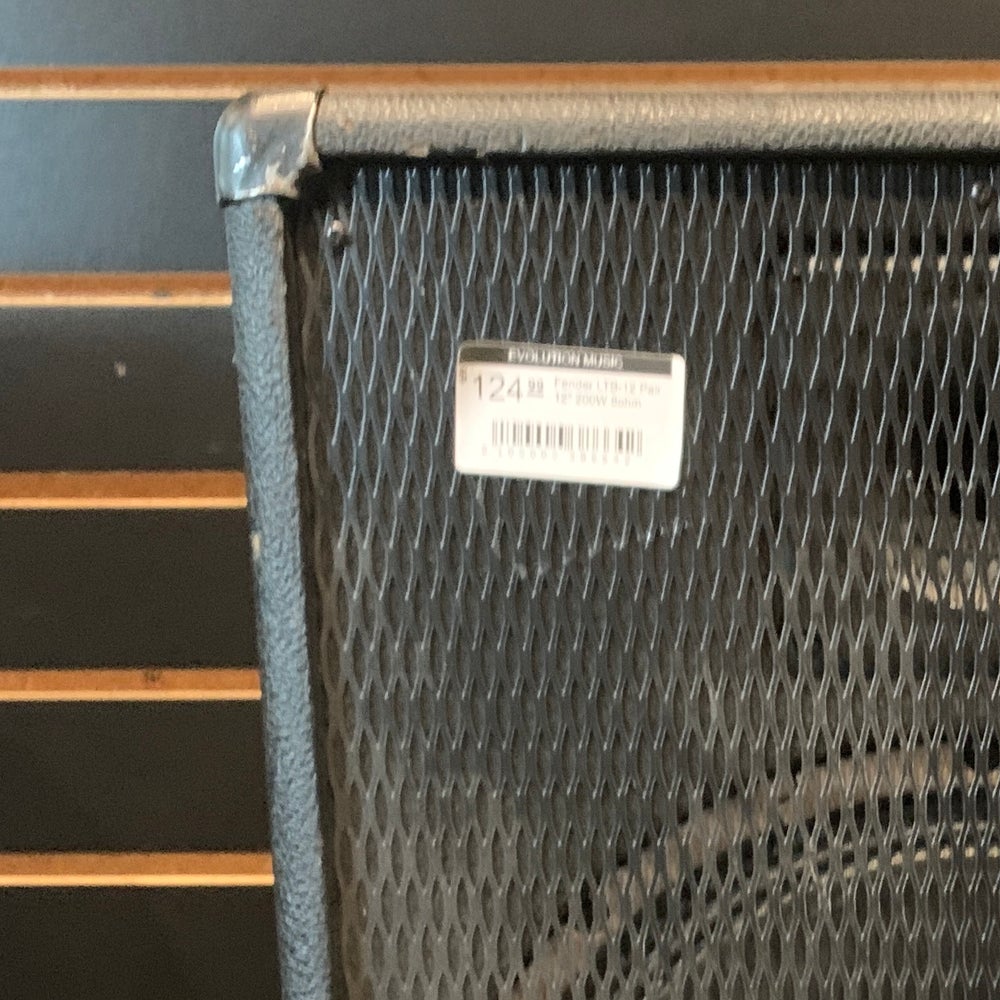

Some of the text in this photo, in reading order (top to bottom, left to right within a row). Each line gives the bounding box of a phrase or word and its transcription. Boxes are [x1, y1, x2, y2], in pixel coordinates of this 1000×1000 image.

[508, 347, 624, 370] EVOLUTION MUSIC
[554, 376, 592, 391] Fender
